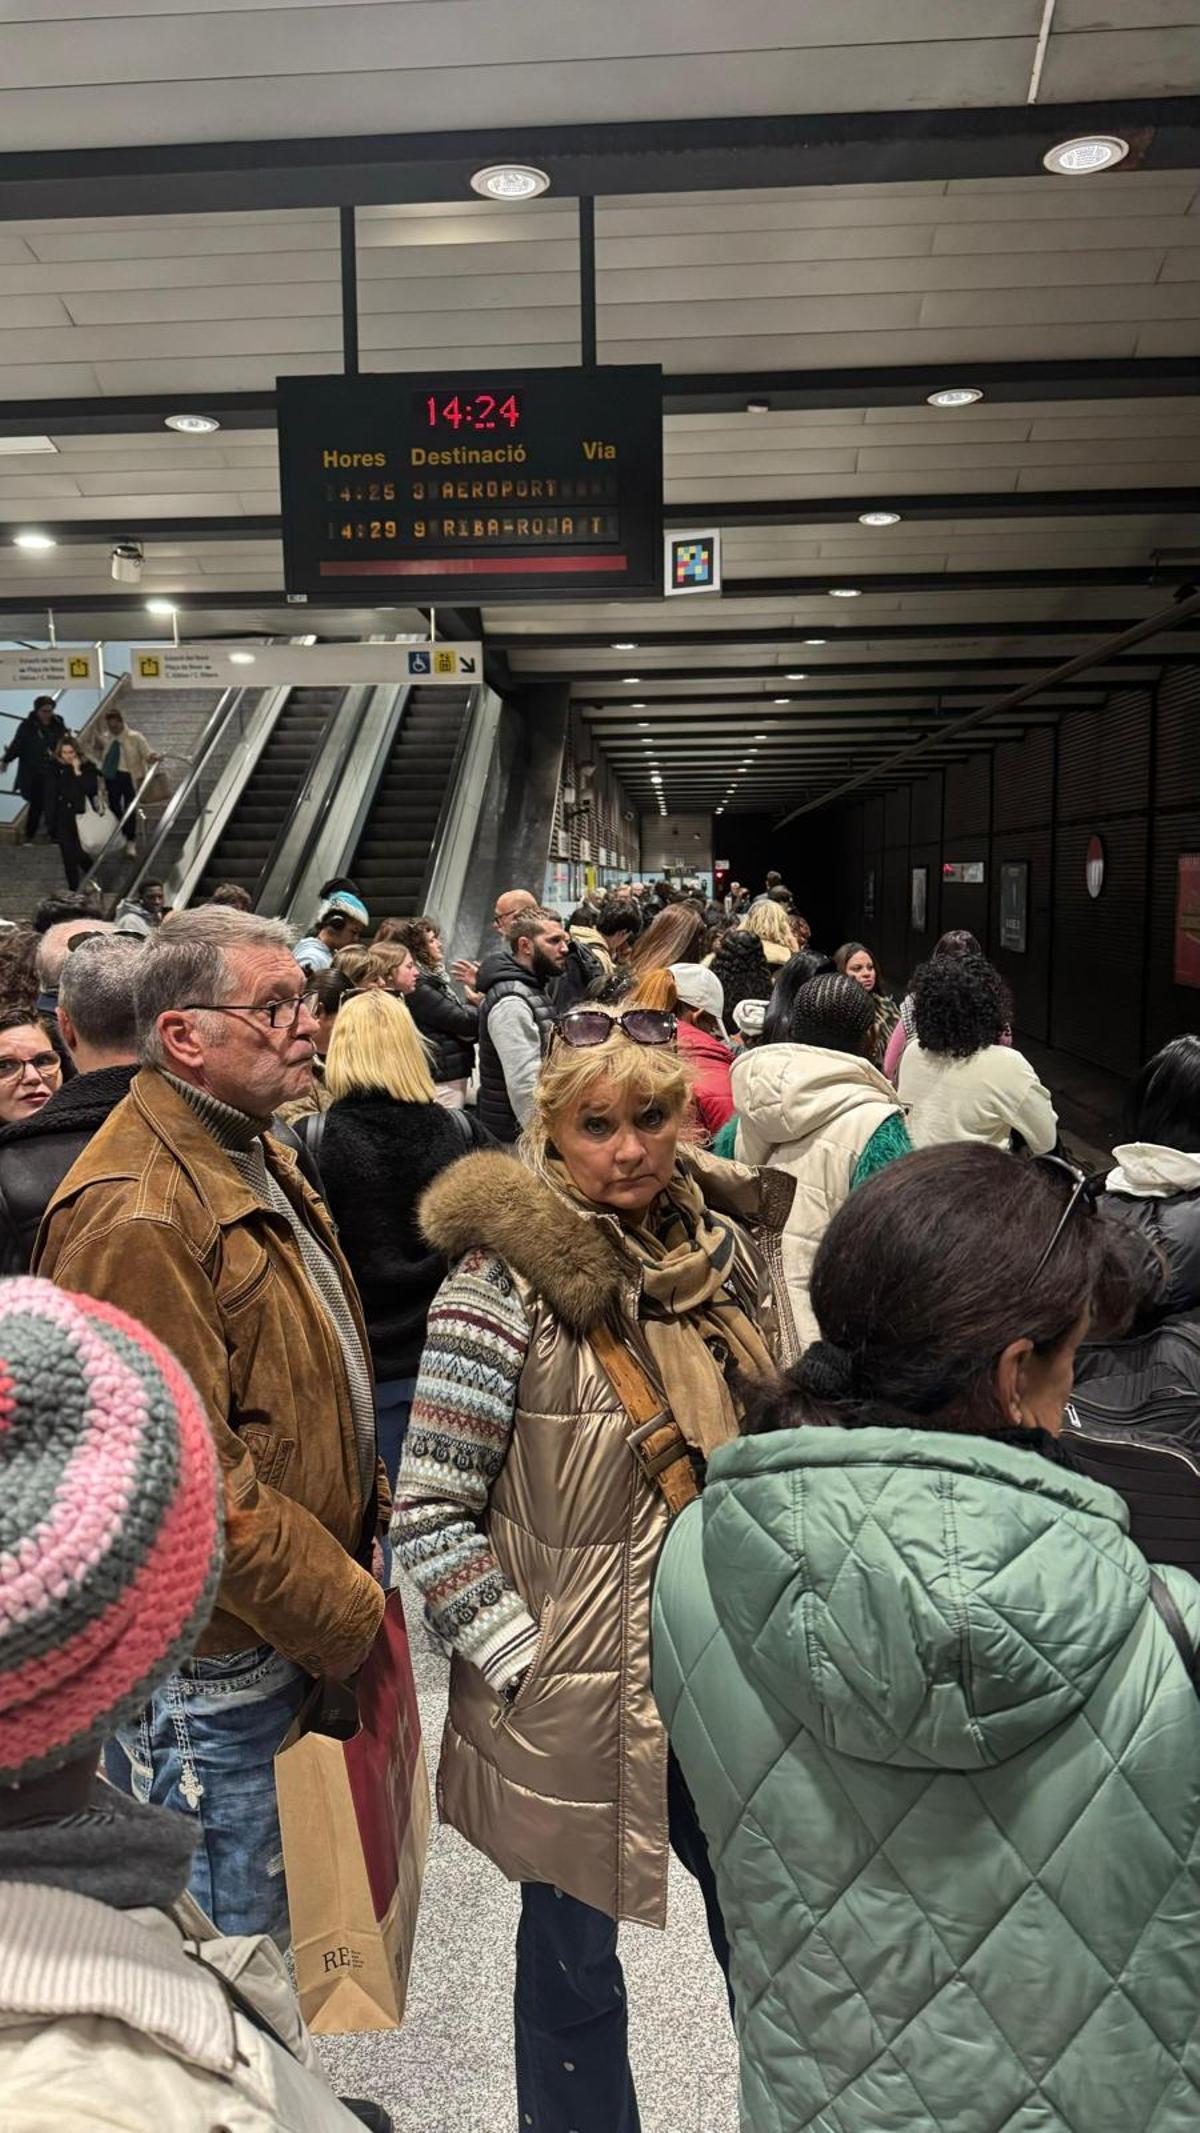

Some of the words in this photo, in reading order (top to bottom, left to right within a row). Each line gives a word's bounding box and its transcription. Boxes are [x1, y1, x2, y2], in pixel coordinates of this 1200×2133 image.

[426, 395, 520, 429] 14:24
[323, 450, 387, 468] Hores
[411, 444, 527, 466] Destinació
[582, 441, 617, 460] Via
[441, 480, 557, 500] AEROPORT
[414, 519, 426, 537] 9
[443, 516, 574, 537] RIBA-ROJA
[322, 1946, 350, 1973] RE
